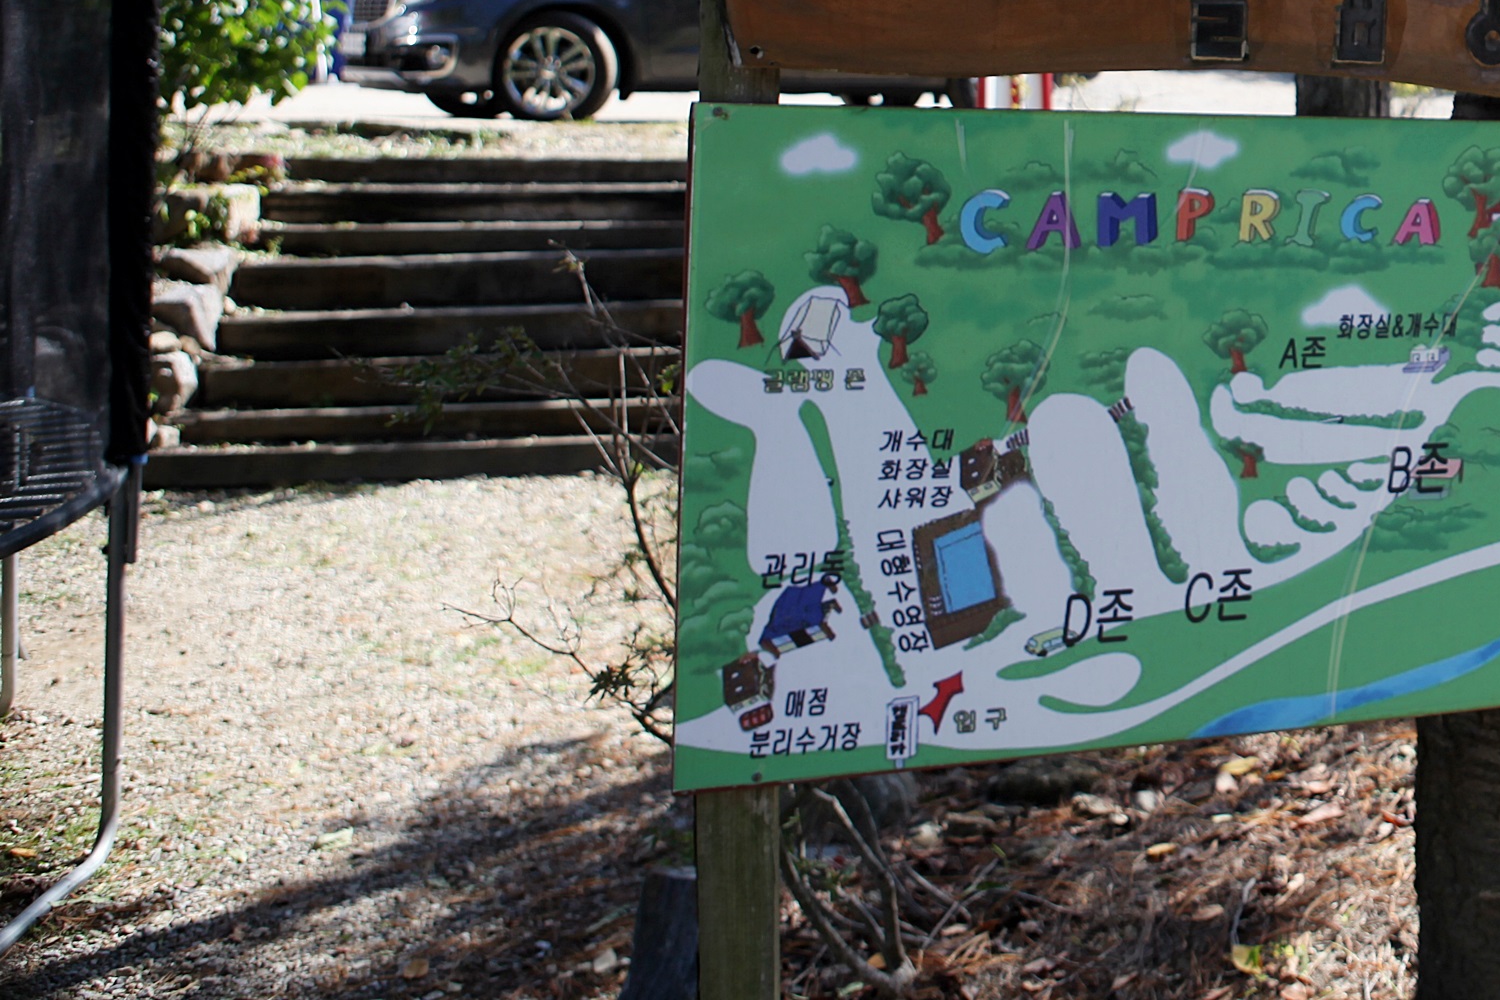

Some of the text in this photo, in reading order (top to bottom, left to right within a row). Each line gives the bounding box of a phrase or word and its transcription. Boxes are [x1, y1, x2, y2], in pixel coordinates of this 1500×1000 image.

[960, 188, 1442, 254] CAMPRICA
[1337, 312, 1458, 340] 화장실&개수대
[1278, 336, 1326, 369] A존
[763, 368, 834, 393] 글램핑
[879, 429, 955, 453] 개수대
[878, 456, 953, 482] 화장실
[1387, 442, 1450, 495] B존
[877, 485, 954, 510] 샤워장
[761, 550, 846, 589] 관리동
[877, 529, 930, 653] 대형수영장
[1184, 568, 1254, 624] C존
[1061, 588, 1134, 646] D존
[784, 687, 828, 718] 매점
[749, 721, 862, 759] 분리수거장
